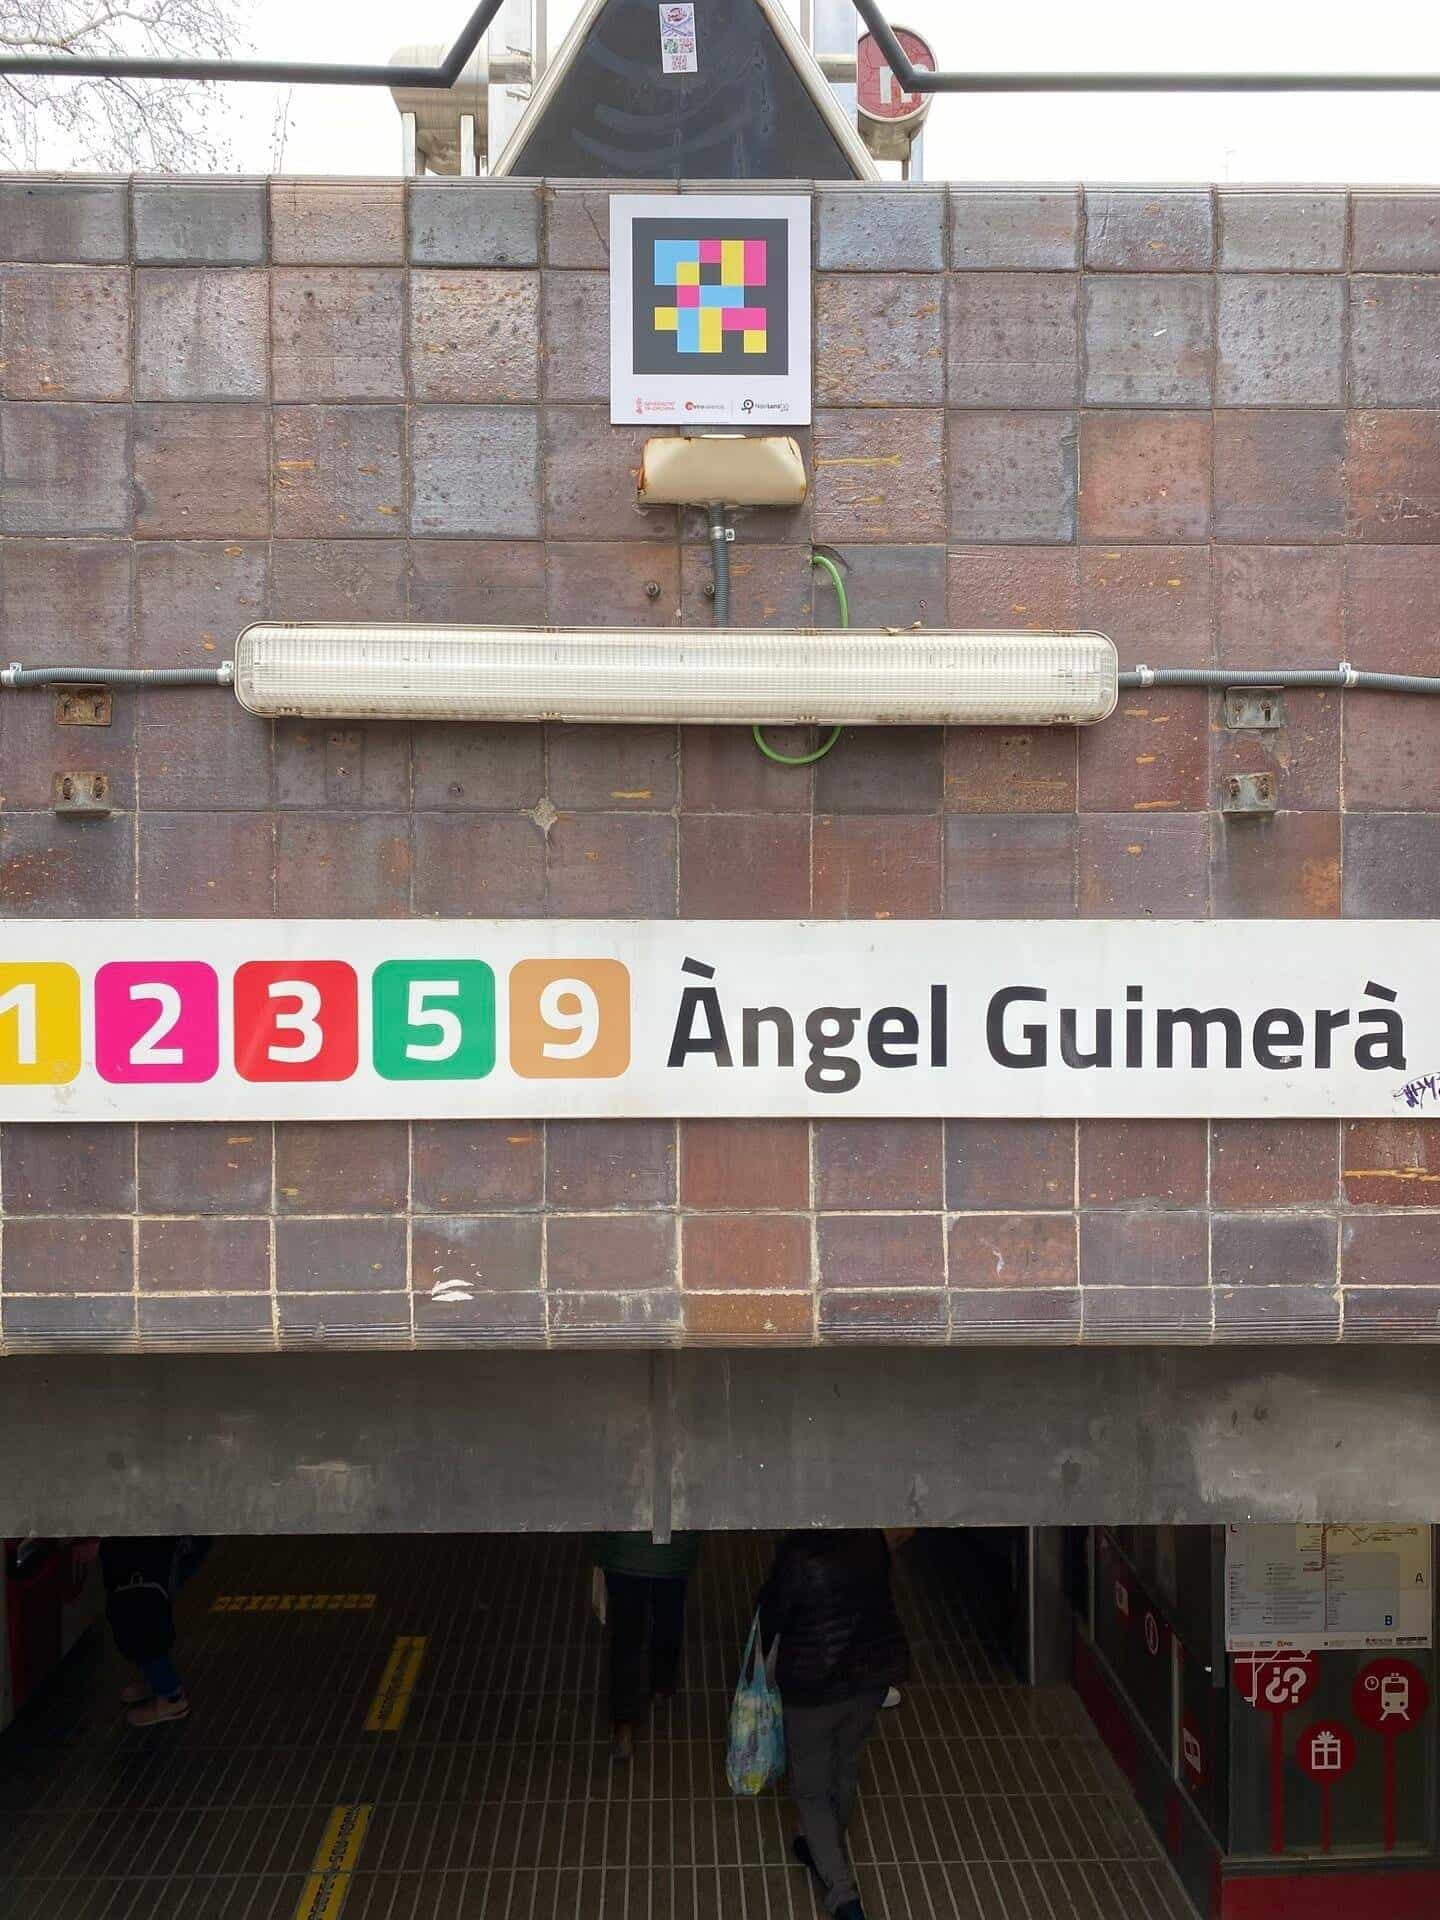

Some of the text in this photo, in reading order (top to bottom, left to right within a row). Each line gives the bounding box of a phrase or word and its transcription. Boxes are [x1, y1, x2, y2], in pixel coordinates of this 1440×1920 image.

[0, 956, 1407, 1094] 1 2 3 5 9 Àngel Guimerà
[1384, 1615, 1393, 1626] B
